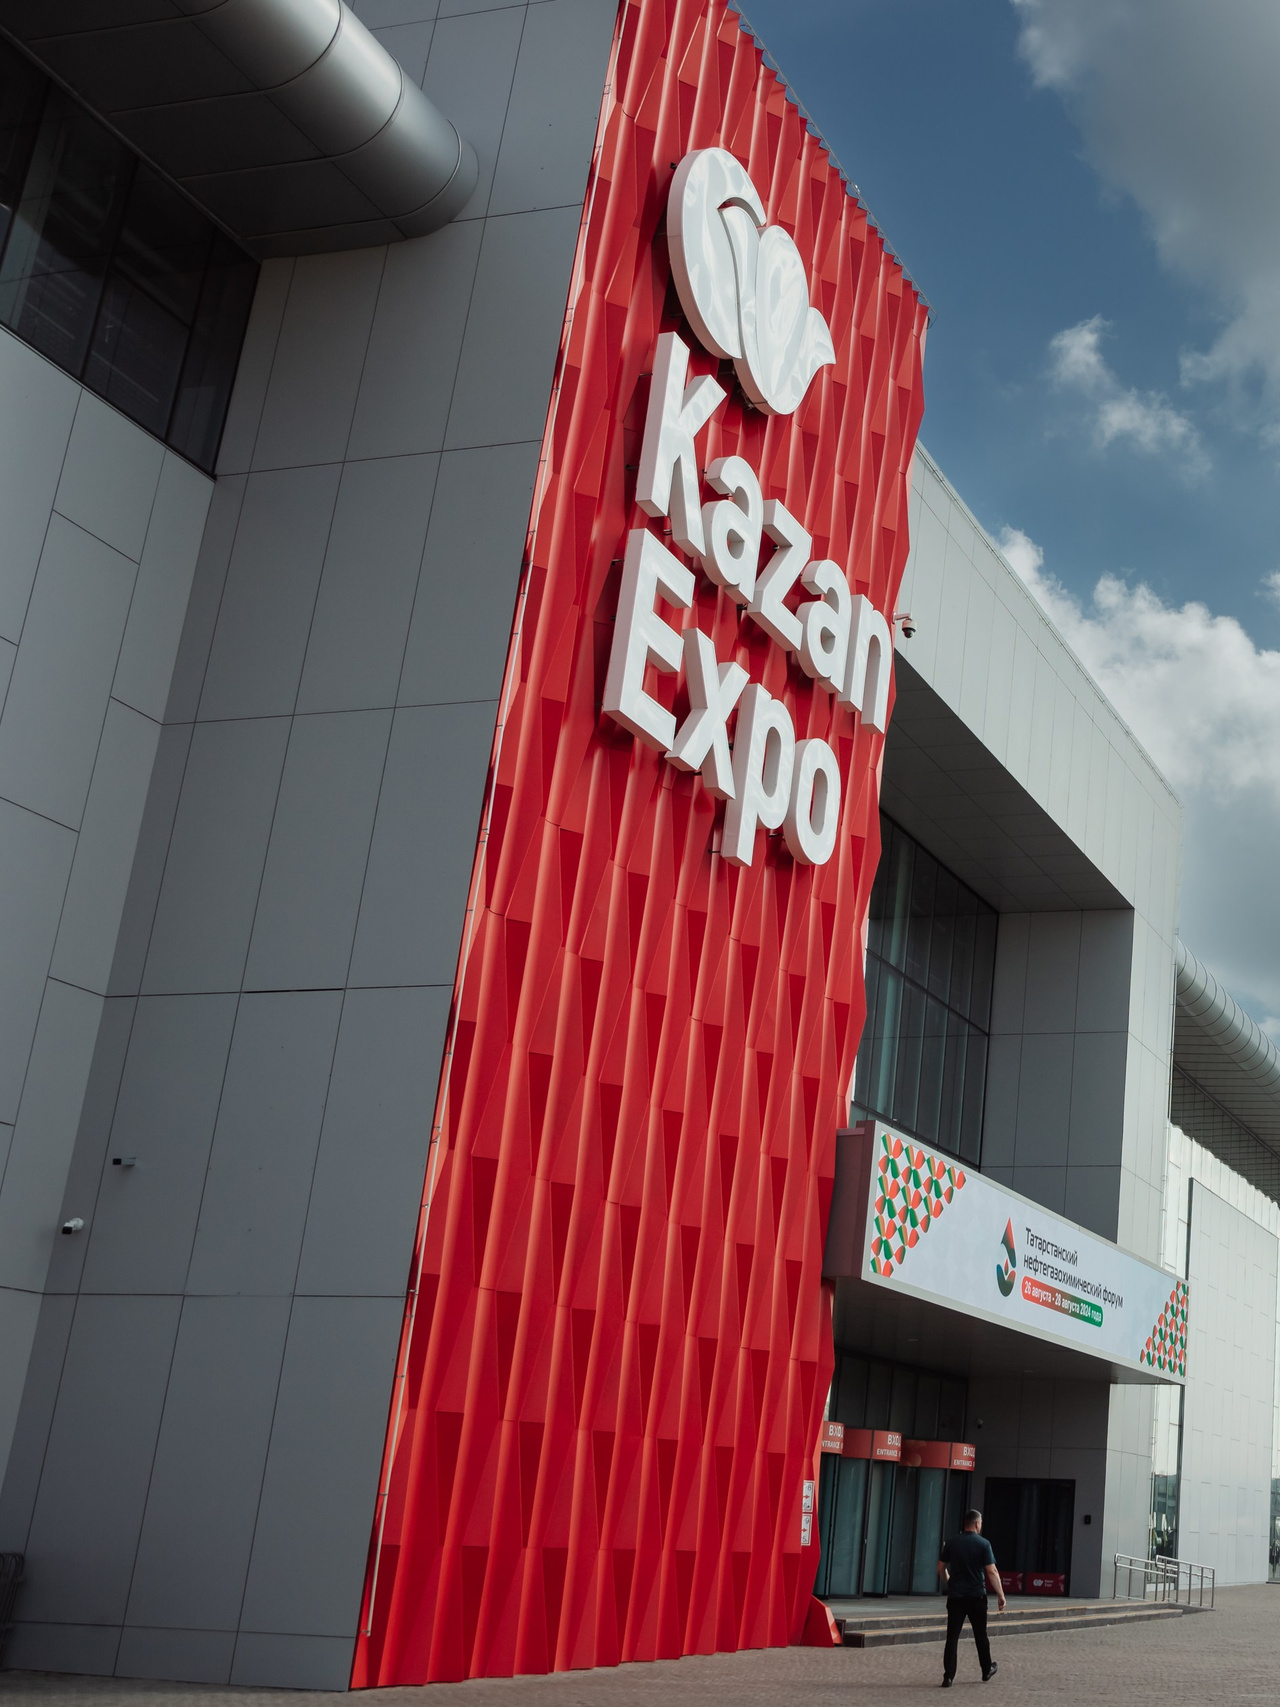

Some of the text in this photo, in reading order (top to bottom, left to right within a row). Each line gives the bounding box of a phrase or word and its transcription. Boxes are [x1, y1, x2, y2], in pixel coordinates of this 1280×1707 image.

[635, 332, 892, 734] Kazan
[603, 528, 841, 867] Expo
[1025, 1227, 1078, 1267] Татарстанский
[1023, 1254, 1123, 1309] нефтегазохимический форум
[1024, 1280, 1032, 1294] 26
[1032, 1286, 1052, 1302] августа
[1061, 1298, 1080, 1313] августа
[1079, 1302, 1091, 1317] 2024
[1091, 1309, 1102, 1322] года
[876, 1448, 898, 1457] ENTRANCE
